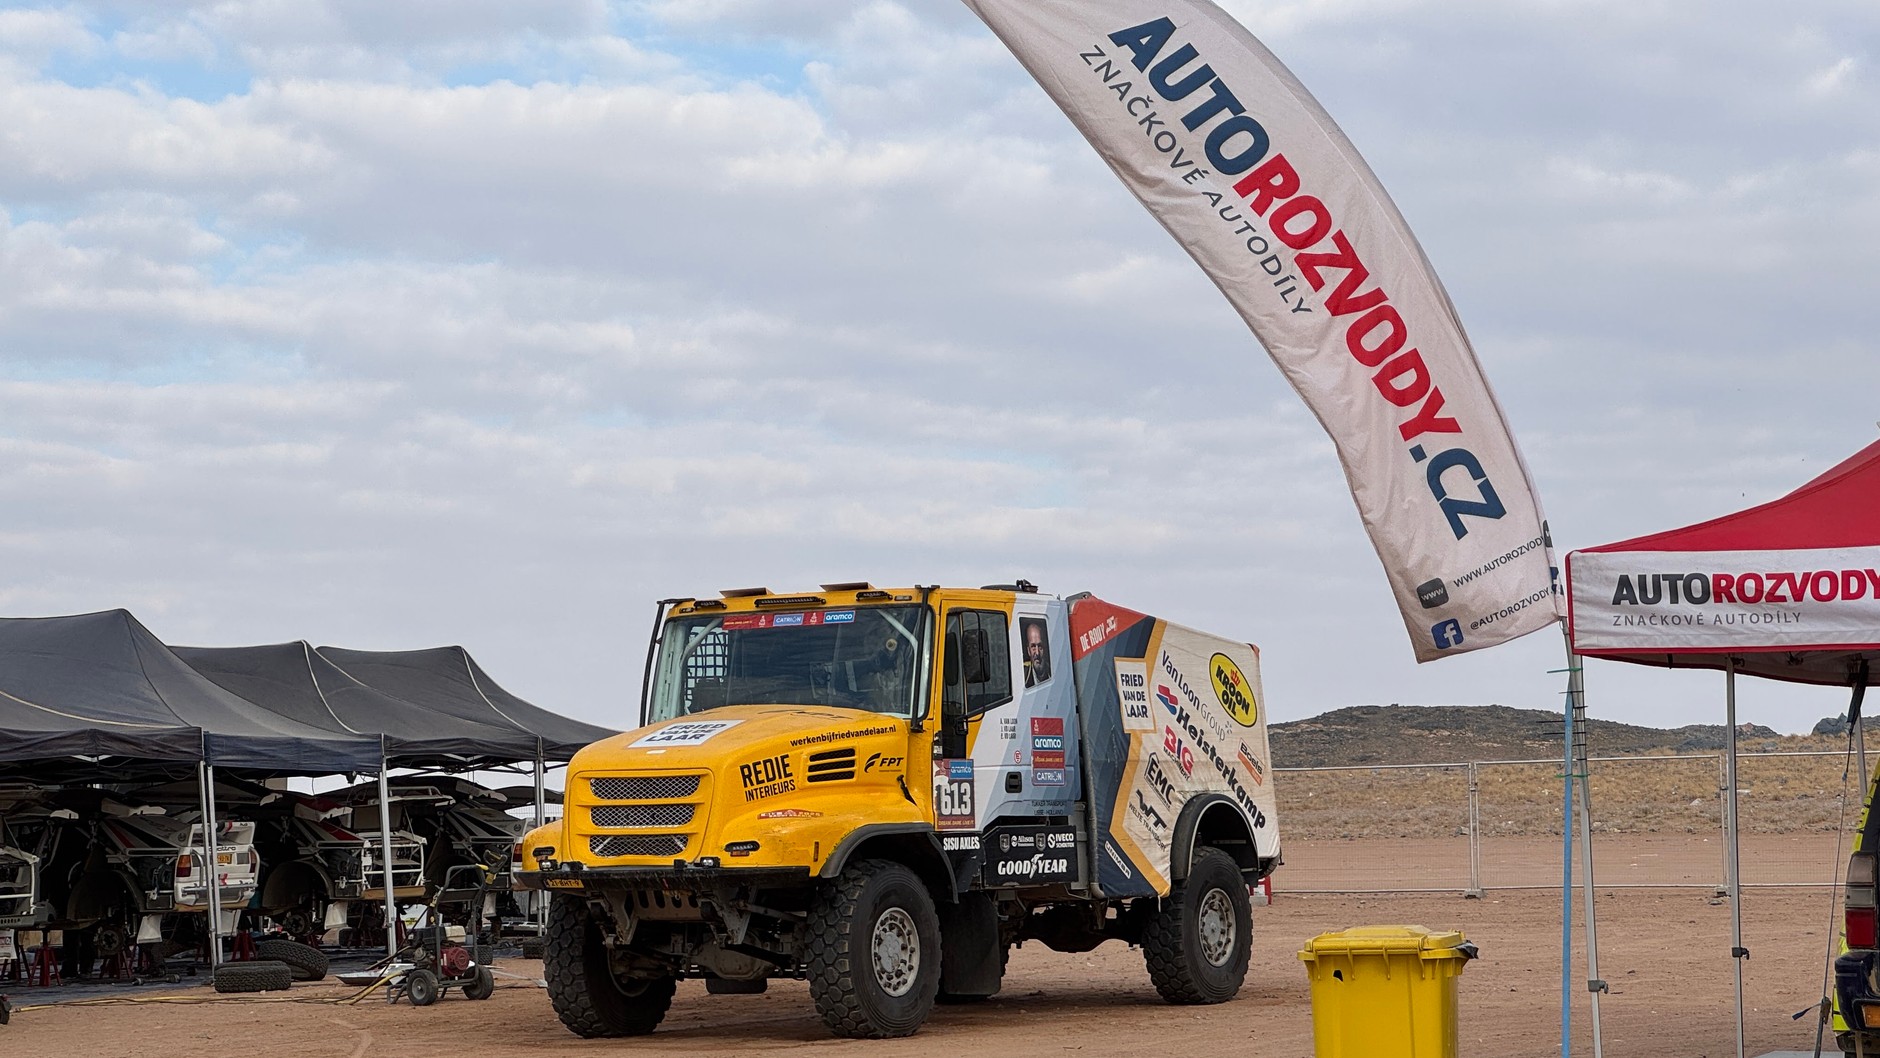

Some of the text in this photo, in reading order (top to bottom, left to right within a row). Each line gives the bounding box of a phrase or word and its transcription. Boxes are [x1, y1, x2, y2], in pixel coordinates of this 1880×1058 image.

[1079, 44, 1313, 314] ZNAČKOVÉ AUTODÍLY
[1107, 16, 1506, 541] AUTOROZVODY.CZ
[1612, 568, 1880, 606] AUTOROZVODY
[825, 612, 853, 621] aramco
[1613, 610, 1802, 627] ZNAČKOVÉ AUTODÍLY
[1080, 633, 1091, 652] DE
[1121, 673, 1144, 687] FRIED
[1215, 665, 1251, 716] KROON
[1123, 690, 1146, 701] VAN DE
[1162, 651, 1226, 742] Van Loon Group
[1222, 691, 1237, 717] OIL
[1125, 704, 1149, 719] LAAR
[645, 734, 706, 742] LAAR
[790, 724, 897, 747] werkenbijfriedvandelaar.nl
[1034, 738, 1062, 748] aramco
[739, 753, 794, 789] REDIE
[879, 757, 904, 767] FPT
[1176, 706, 1266, 829] Heisterkamp
[745, 779, 796, 803] INTERIEURS
[1147, 757, 1176, 805] EMC
[940, 782, 972, 816] 613
[943, 836, 980, 850] SISU AXLES
[1055, 833, 1075, 841] IVECO
[997, 856, 1068, 877] GOODYEAR
